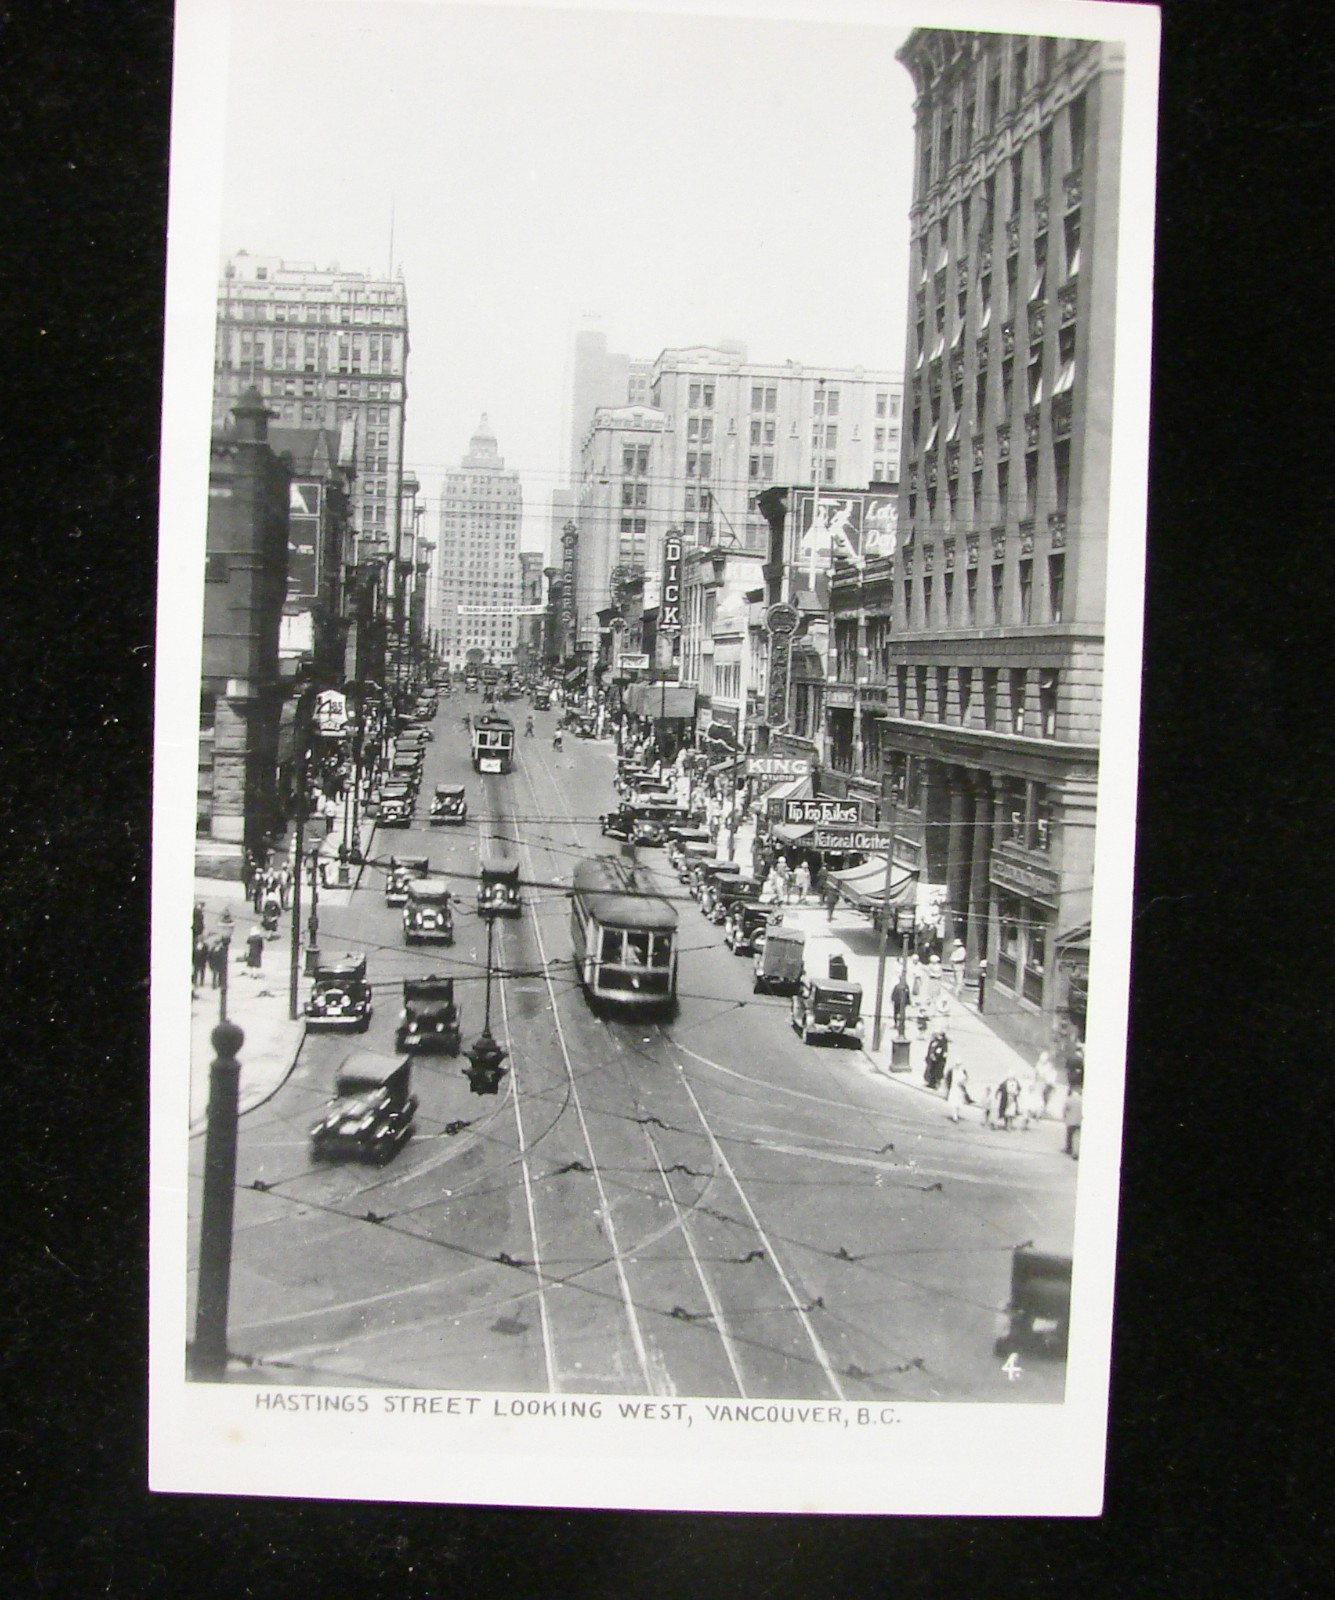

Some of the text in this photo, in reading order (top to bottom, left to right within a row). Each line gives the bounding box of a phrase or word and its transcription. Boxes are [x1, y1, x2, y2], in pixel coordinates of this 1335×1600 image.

[664, 544, 681, 624] DICK
[748, 758, 808, 774] KING
[787, 801, 858, 822] Tip Top Tailors
[815, 831, 854, 849] National
